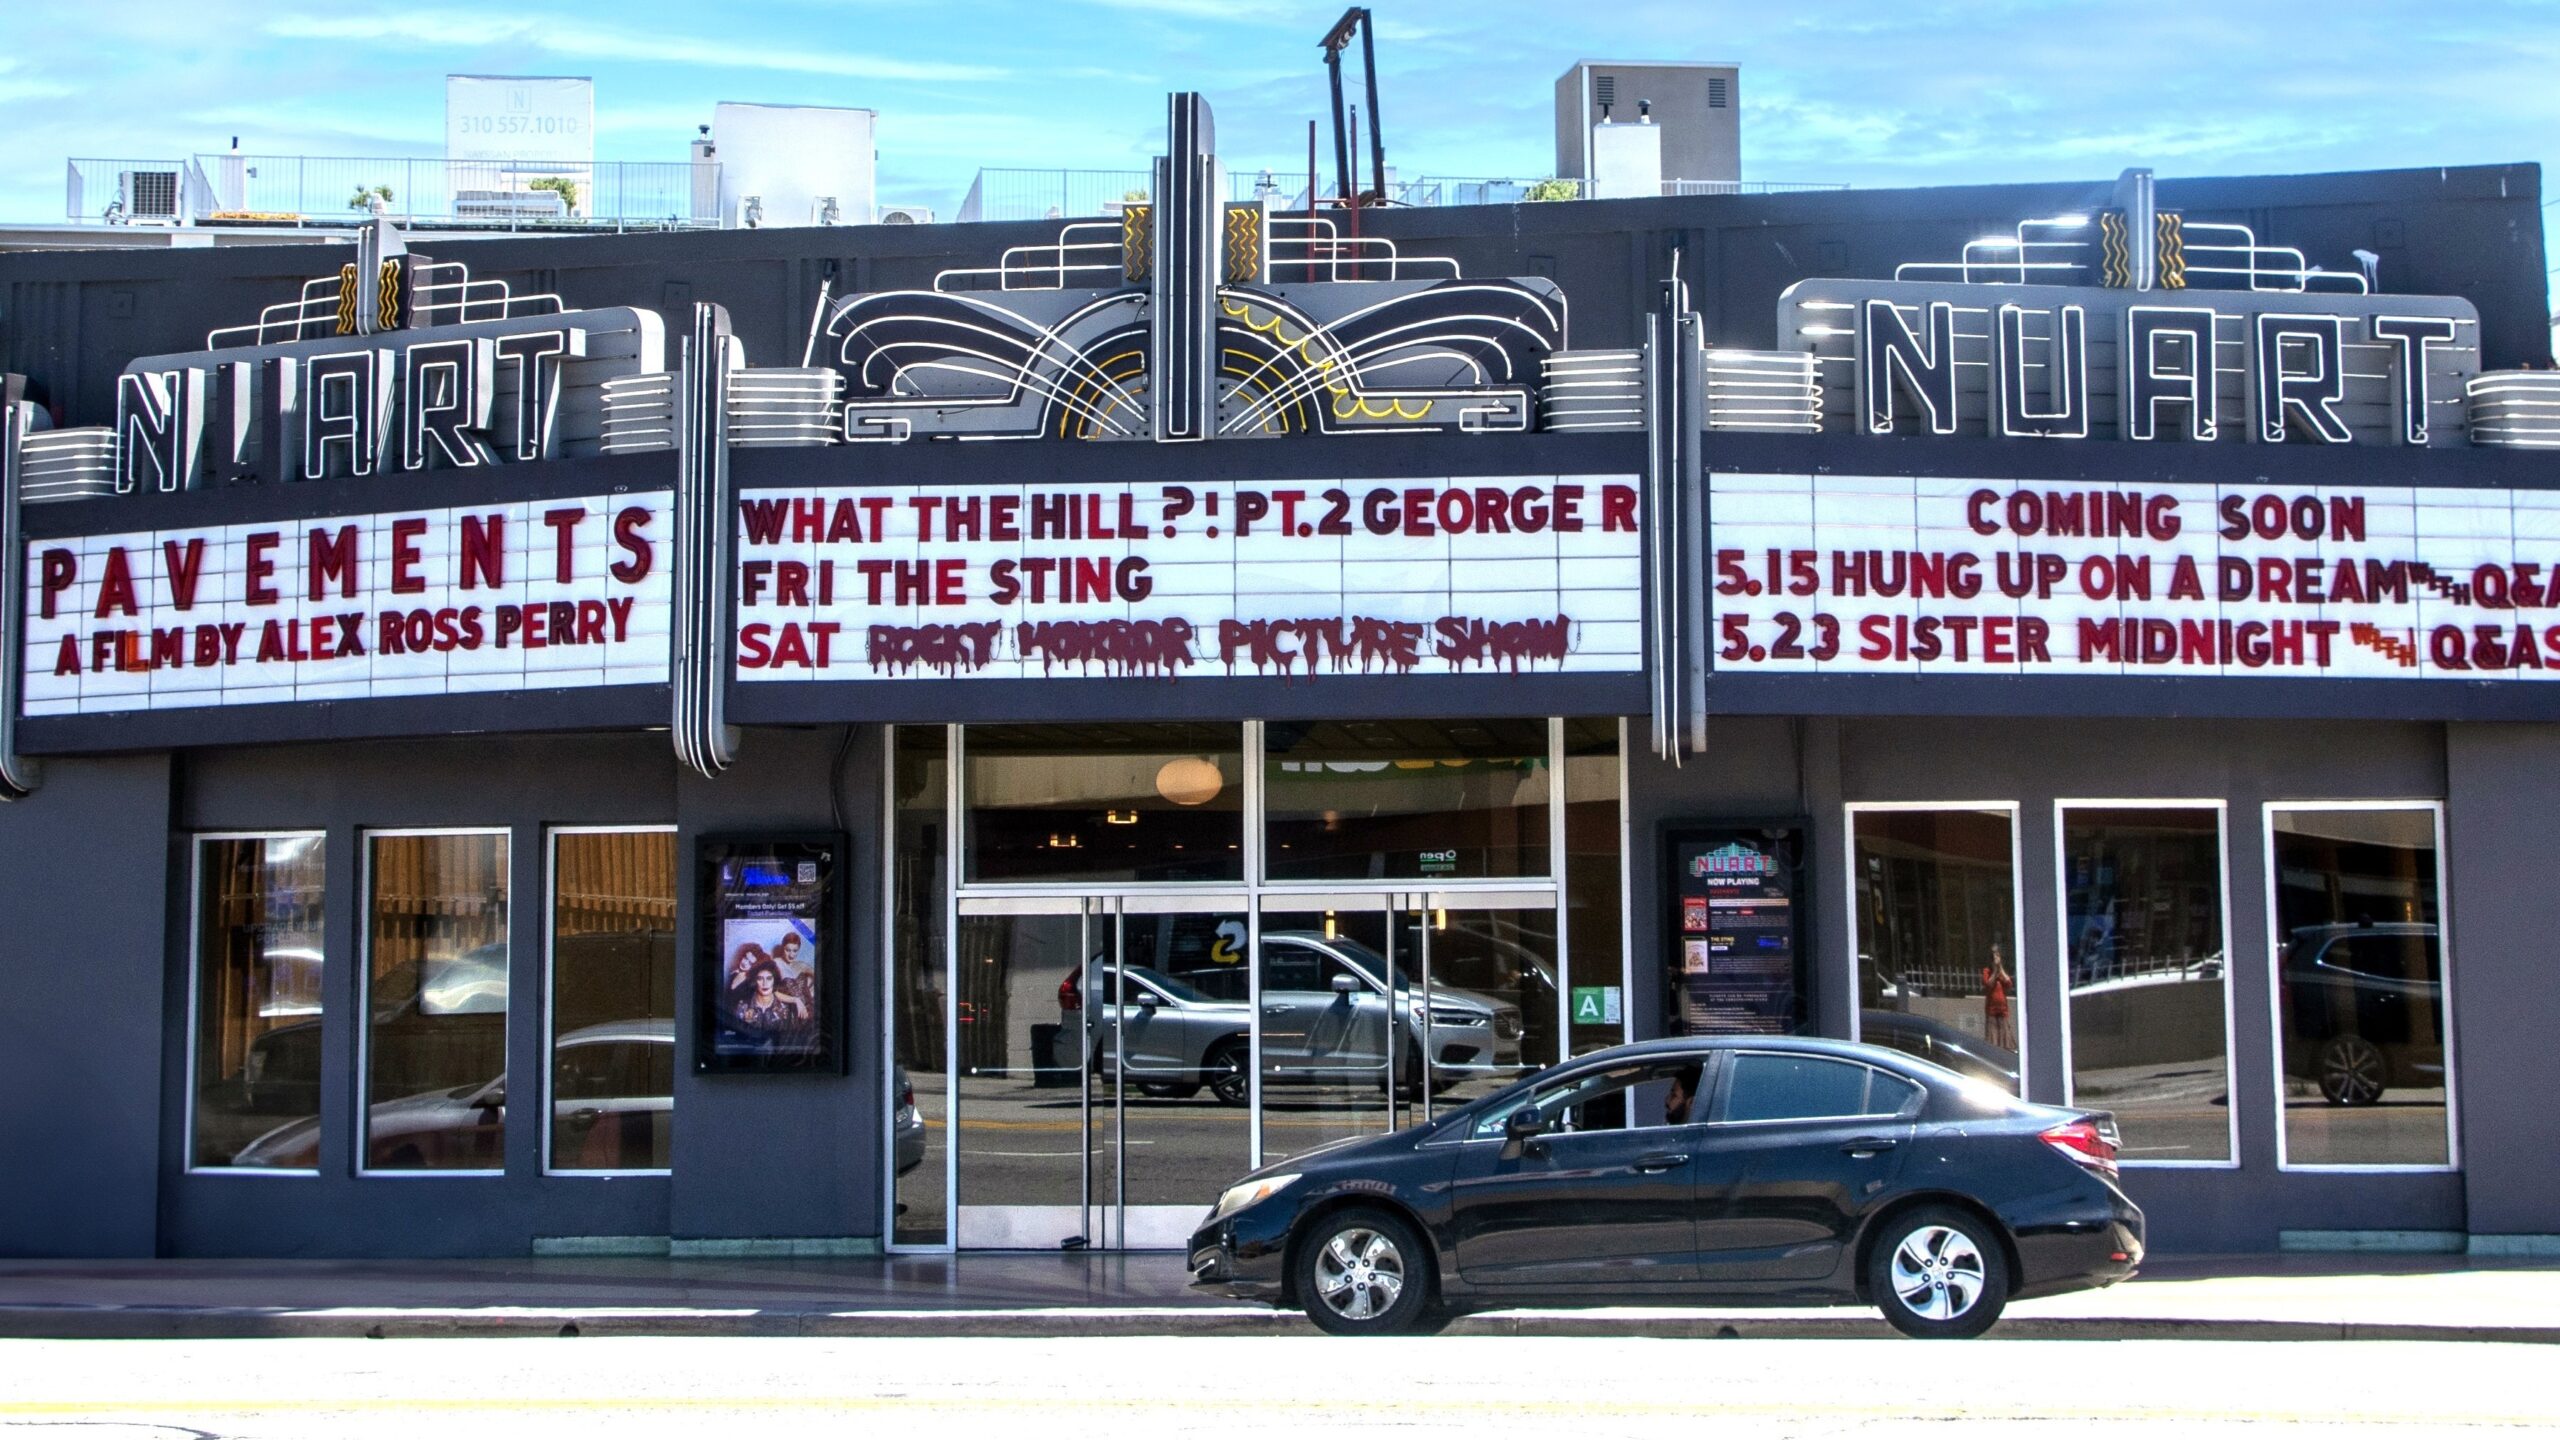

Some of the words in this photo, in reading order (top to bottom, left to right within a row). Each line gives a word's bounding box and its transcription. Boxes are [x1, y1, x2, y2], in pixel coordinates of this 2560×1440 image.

[459, 115, 493, 135] 310
[496, 115, 578, 135] 557.1010
[1857, 299, 2457, 446] NUART
[740, 496, 893, 545] WHAT
[908, 495, 1020, 542] THE
[1363, 485, 1584, 537] GEORGE
[1602, 484, 1638, 533] R
[1967, 488, 2181, 542] COMING
[2218, 494, 2367, 542] SOON
[41, 506, 653, 619] PAVEMENTS
[741, 559, 834, 607] FRI
[857, 558, 967, 606] THE
[989, 556, 1154, 606] STING
[1716, 548, 1820, 597] 5.15
[1832, 550, 1982, 599] HUNG
[1996, 551, 2067, 600] UP
[2079, 554, 2151, 601] ON
[2168, 555, 2205, 602] A
[2218, 556, 2409, 605] DREAM
[2406, 561, 2471, 606] WITH
[55, 634, 81, 676] A
[92, 626, 183, 673] FILM
[194, 622, 246, 667] BY
[257, 612, 366, 663] ALEX
[378, 607, 484, 655] ROSS
[495, 596, 635, 648] PERRY
[739, 621, 840, 670] SAT
[868, 619, 1002, 679] ROCKY
[1016, 617, 1194, 684] HORROR
[1218, 614, 1425, 688] PICTURE
[1434, 613, 1571, 679] SHOW
[1721, 611, 1841, 662] 5.23
[1858, 613, 2051, 663] SISTER
[2079, 616, 2341, 667] MIDNIGHT
[2349, 621, 2417, 668] WITH
[1696, 855, 1771, 875] NUART
[1707, 878, 1726, 886] NOW
[1727, 877, 1760, 886] PLAYING
[1578, 995, 1600, 1016] A
